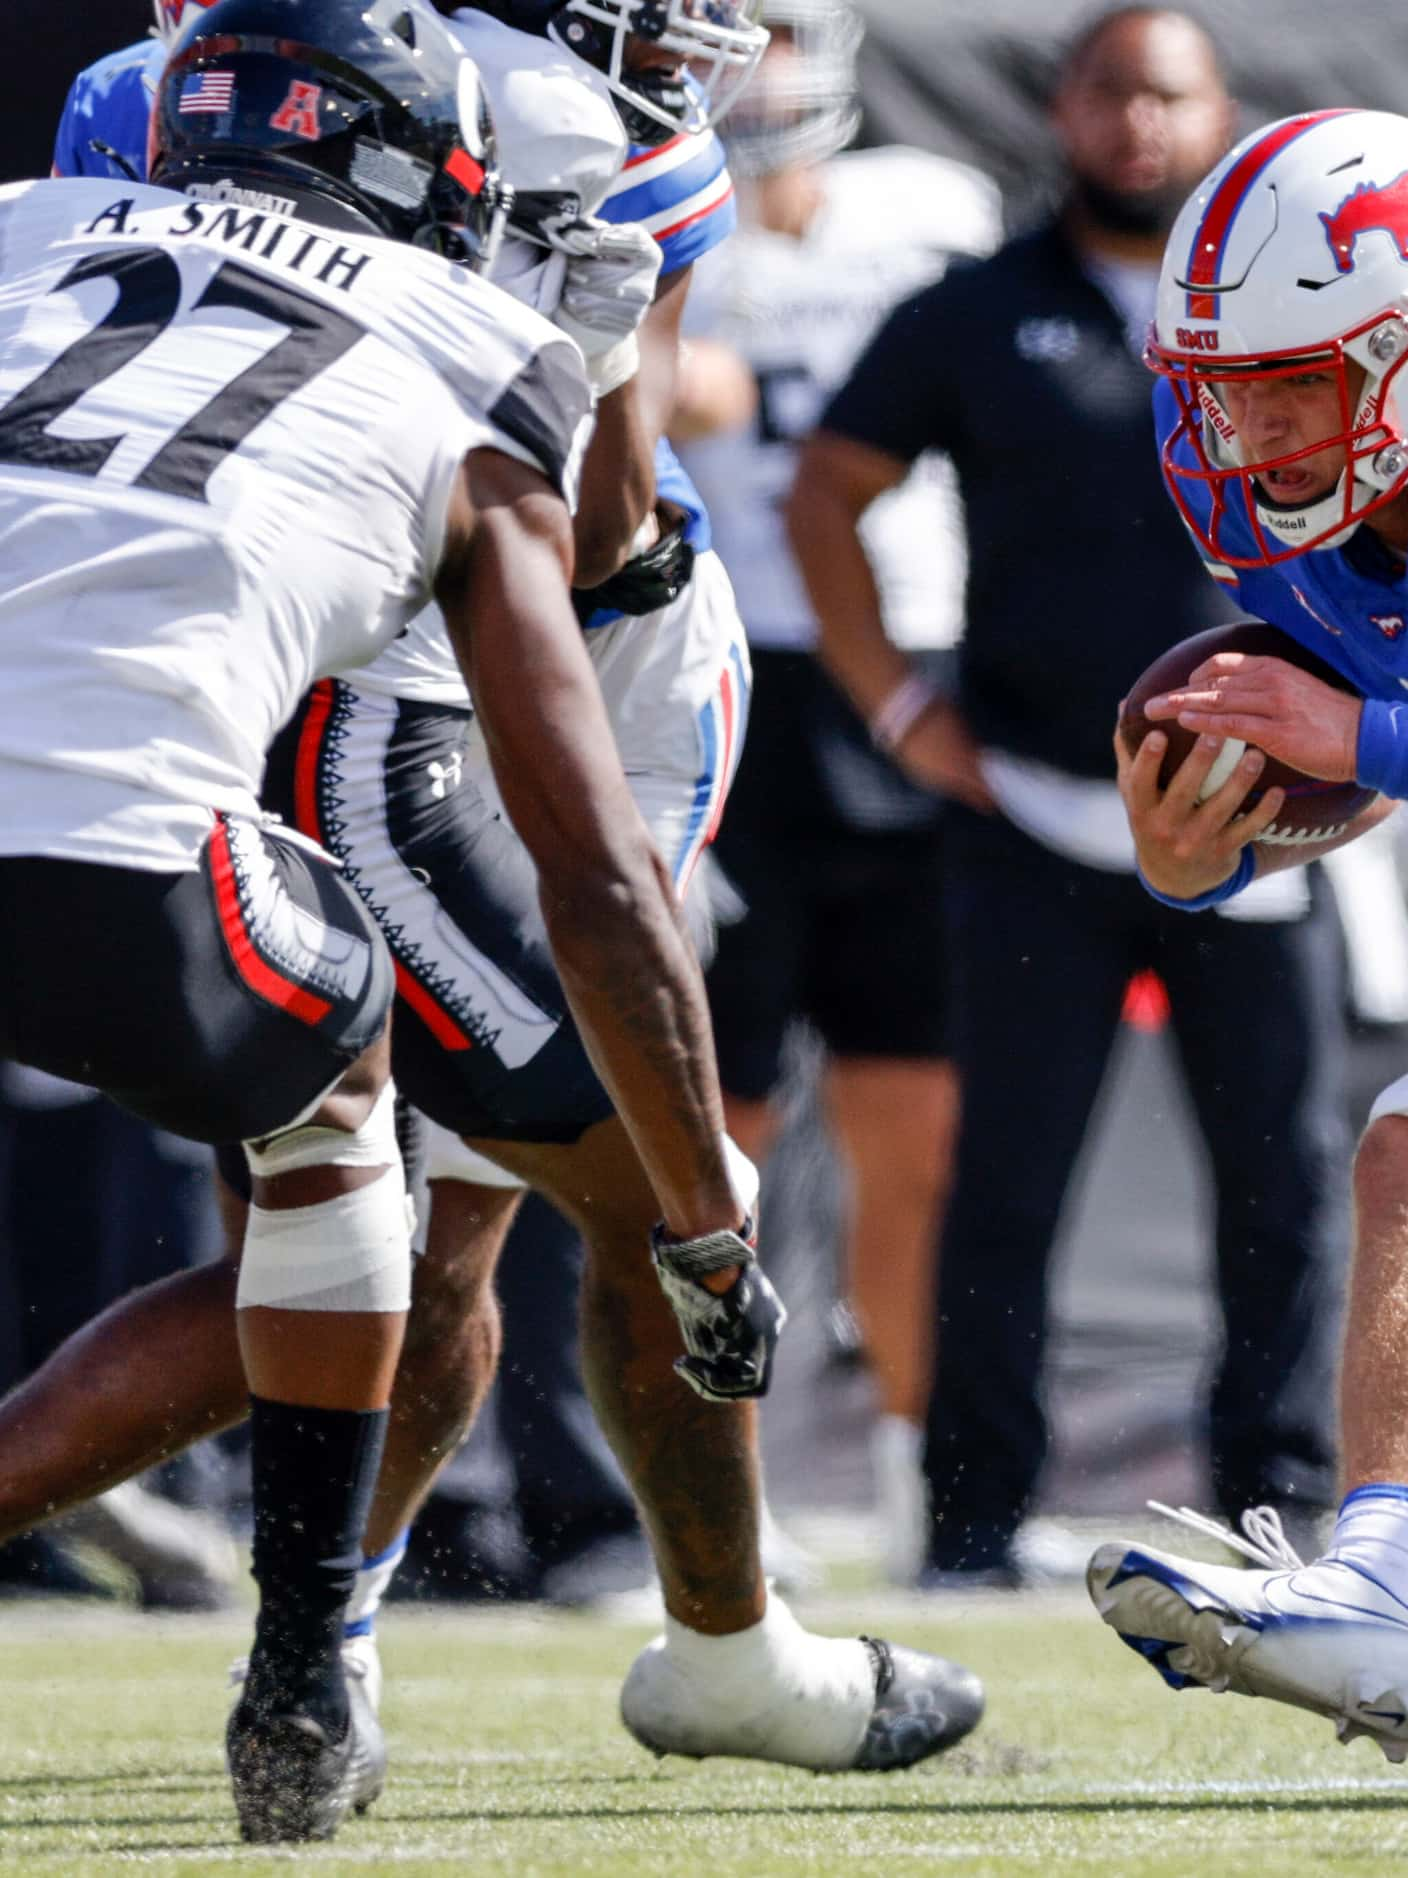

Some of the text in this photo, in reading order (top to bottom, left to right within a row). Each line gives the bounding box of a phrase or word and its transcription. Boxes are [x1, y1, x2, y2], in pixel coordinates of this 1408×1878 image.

[84, 199, 373, 292] A. SMITH
[0, 247, 370, 505] 27
[1175, 327, 1219, 350] SMU
